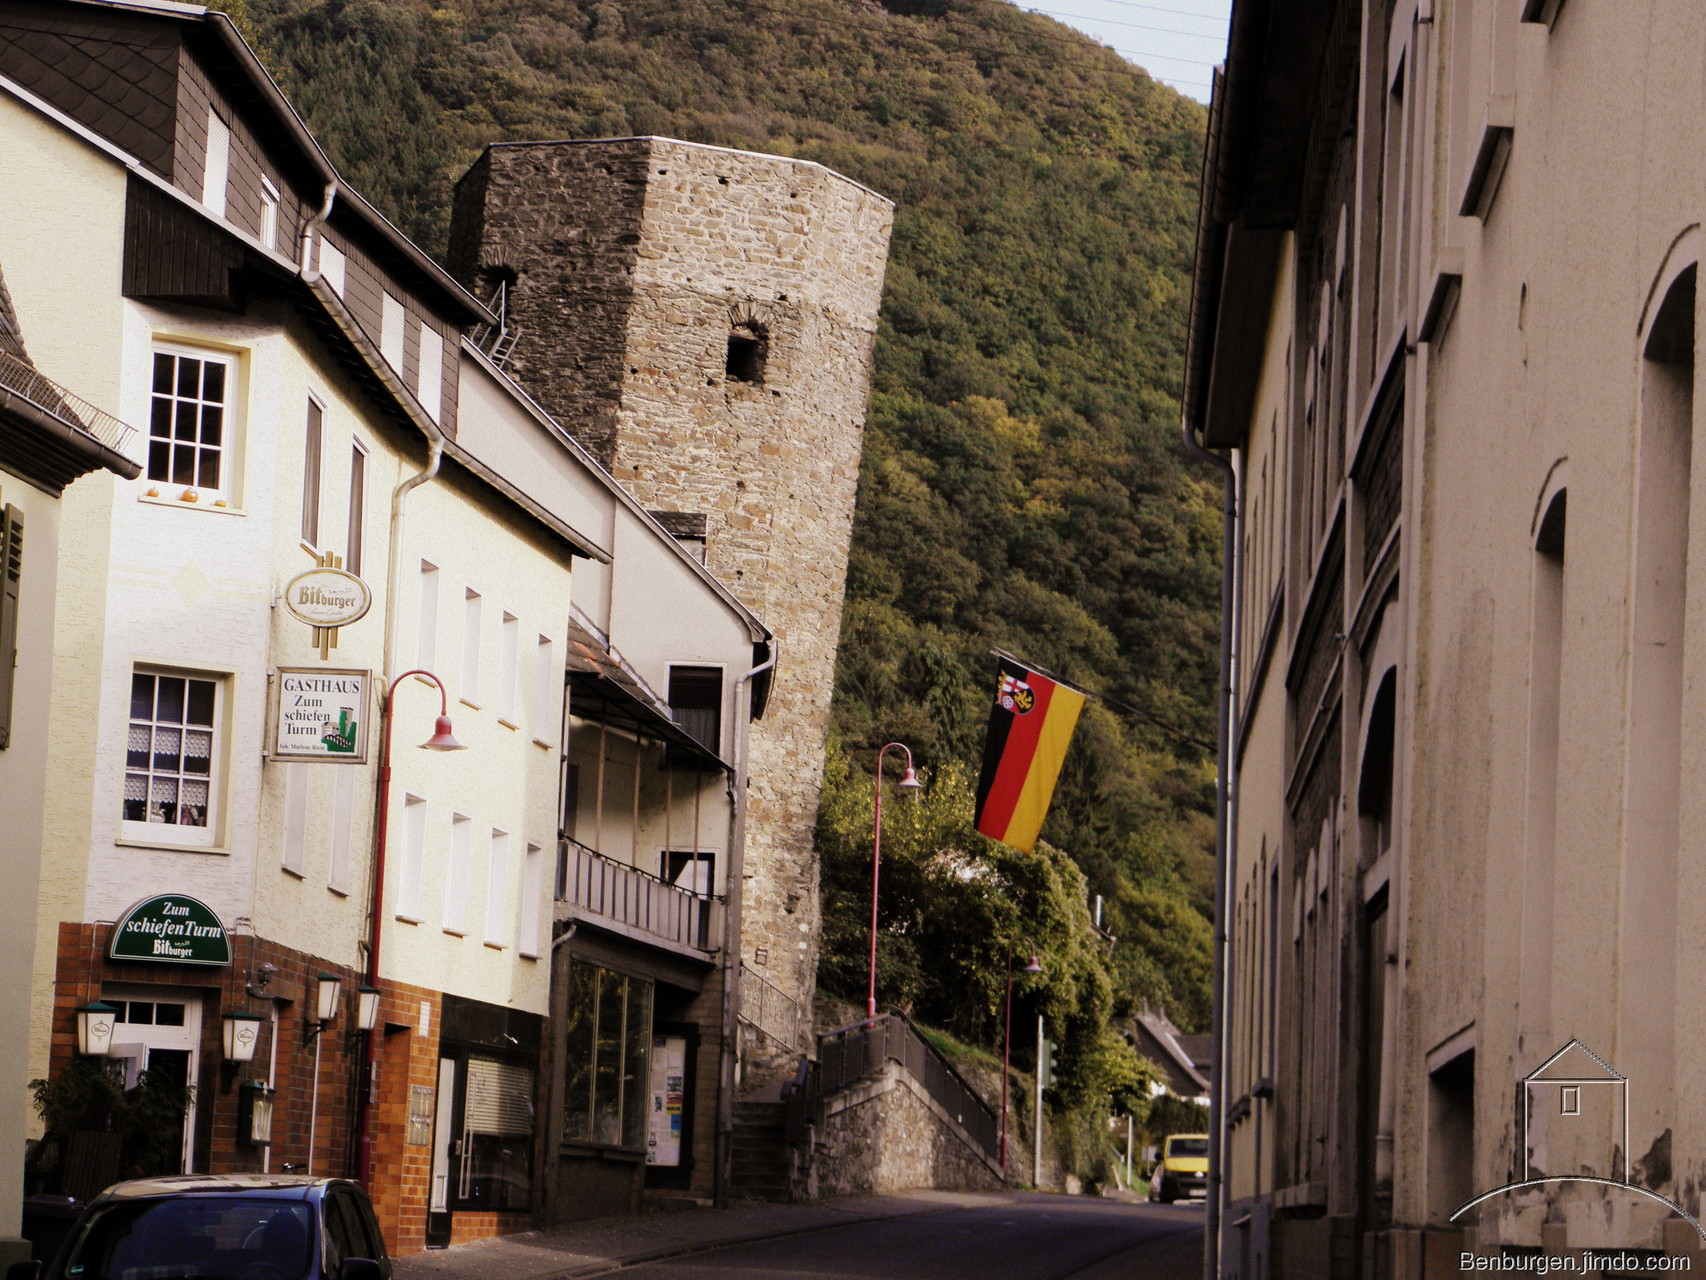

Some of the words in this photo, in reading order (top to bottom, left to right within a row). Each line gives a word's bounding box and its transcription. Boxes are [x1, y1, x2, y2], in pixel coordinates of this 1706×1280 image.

[297, 586, 356, 609] Bitburger
[284, 678, 360, 694] GASTHAUS
[294, 694, 323, 707] Zum
[284, 709, 331, 722] schiefen
[284, 722, 317, 736] Turm
[162, 901, 190, 916] Zum
[126, 917, 184, 938] schiefen
[185, 920, 222, 939] Turm
[152, 939, 193, 958] Bitburger
